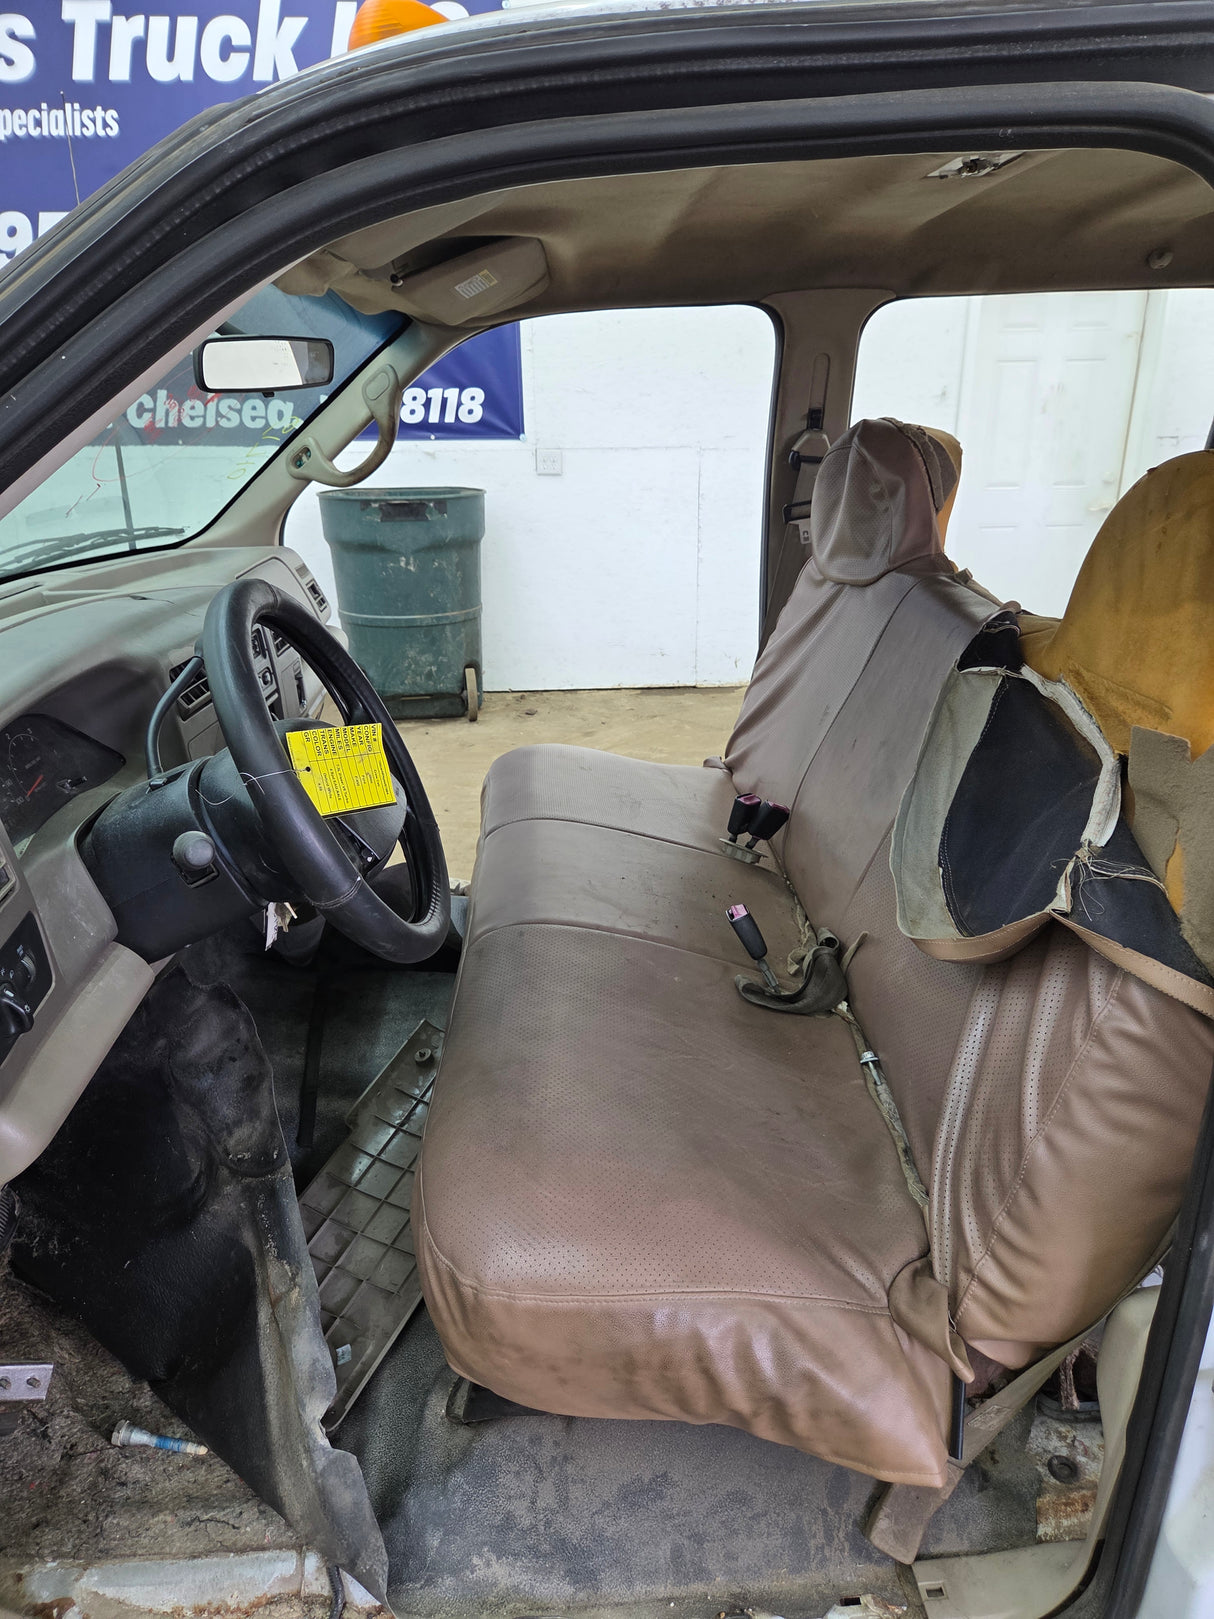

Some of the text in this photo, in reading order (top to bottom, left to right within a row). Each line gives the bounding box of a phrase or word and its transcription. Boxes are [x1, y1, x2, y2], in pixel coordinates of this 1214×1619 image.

[62, 2, 307, 81] Truck
[0, 102, 119, 140] pecialists
[401, 387, 484, 424] 8118
[303, 731, 311, 743] GR
[311, 730, 323, 757] COLOR
[319, 730, 330, 755] TRANS
[327, 729, 338, 757] ENGINE
[334, 728, 344, 751] MILES
[341, 727, 352, 753] MODEL
[349, 726, 358, 747] MAKE
[356, 726, 364, 746] YEAR
[363, 725, 373, 752] CONFIG
